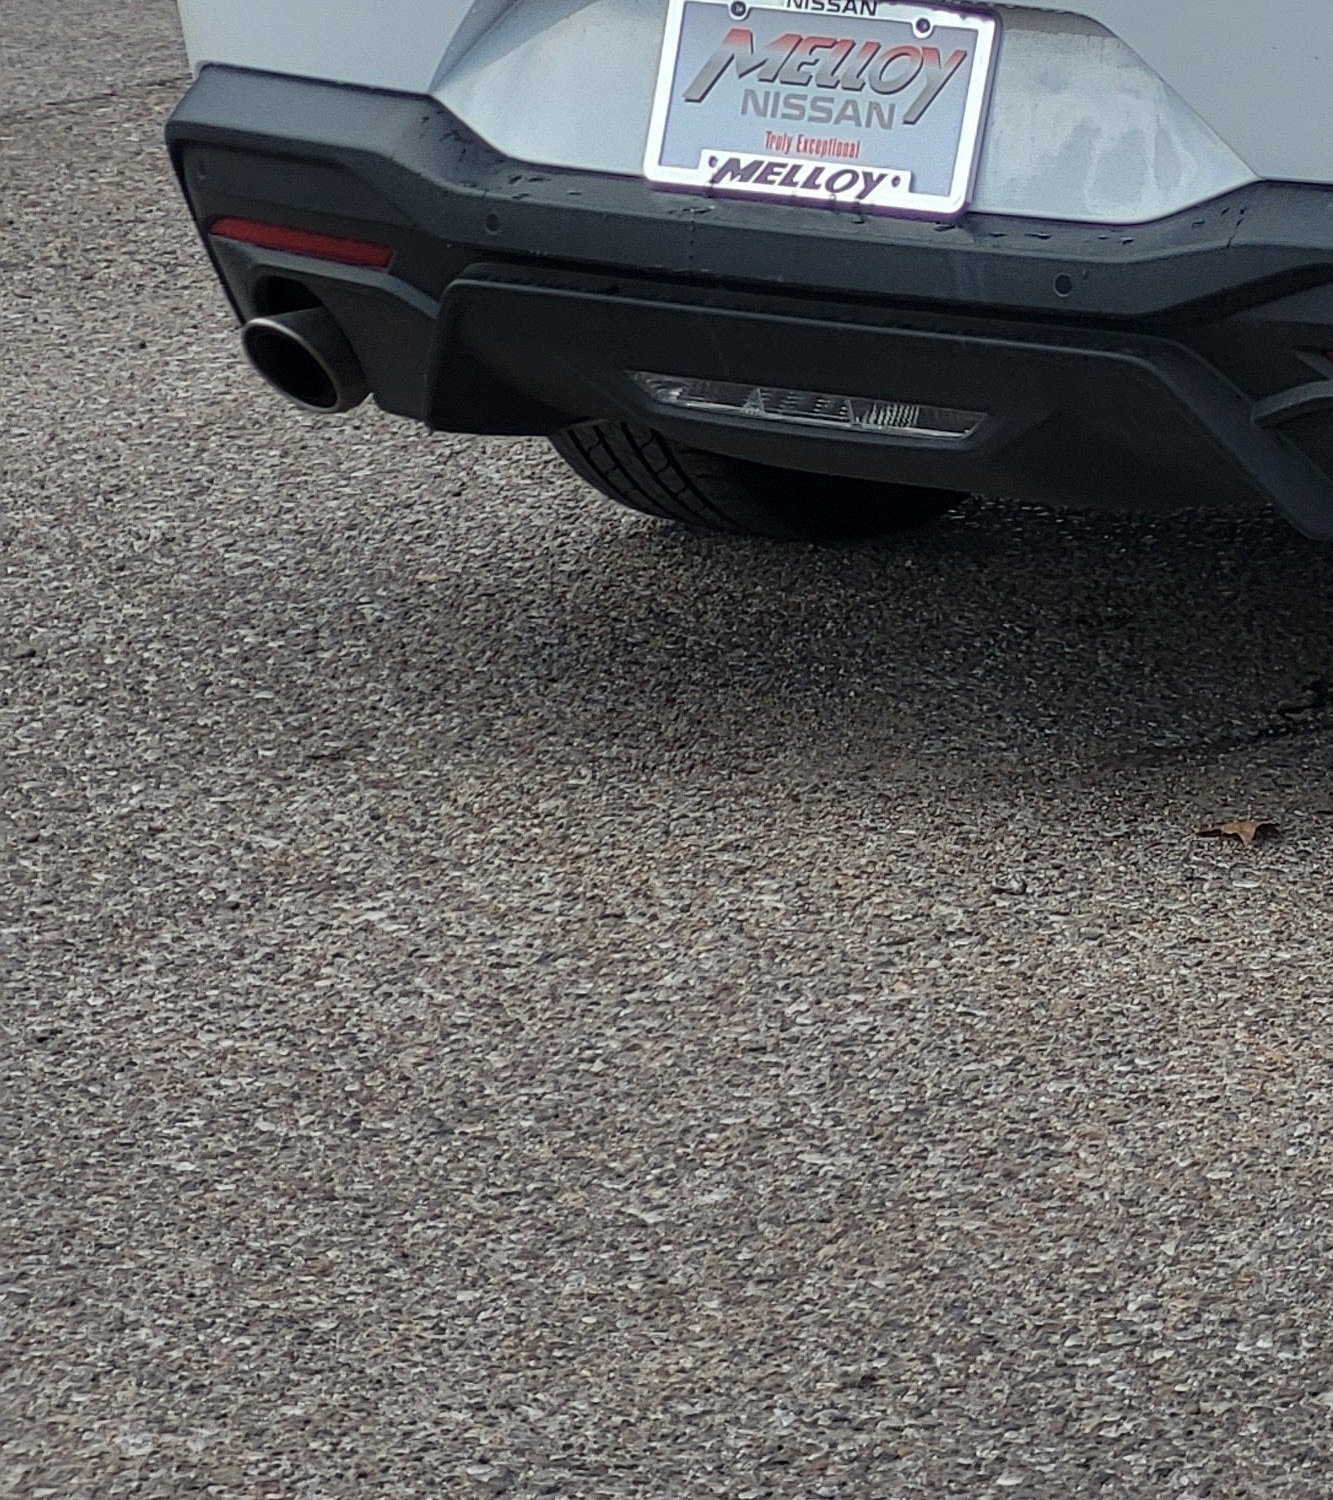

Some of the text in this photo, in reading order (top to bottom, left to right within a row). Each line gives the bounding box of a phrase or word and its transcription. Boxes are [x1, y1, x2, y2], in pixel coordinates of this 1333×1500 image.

[683, 27, 969, 127] MELLOY
[741, 88, 896, 131] NISSAN
[765, 130, 861, 159] Truly Exceptional
[710, 157, 888, 201] MELLOY
